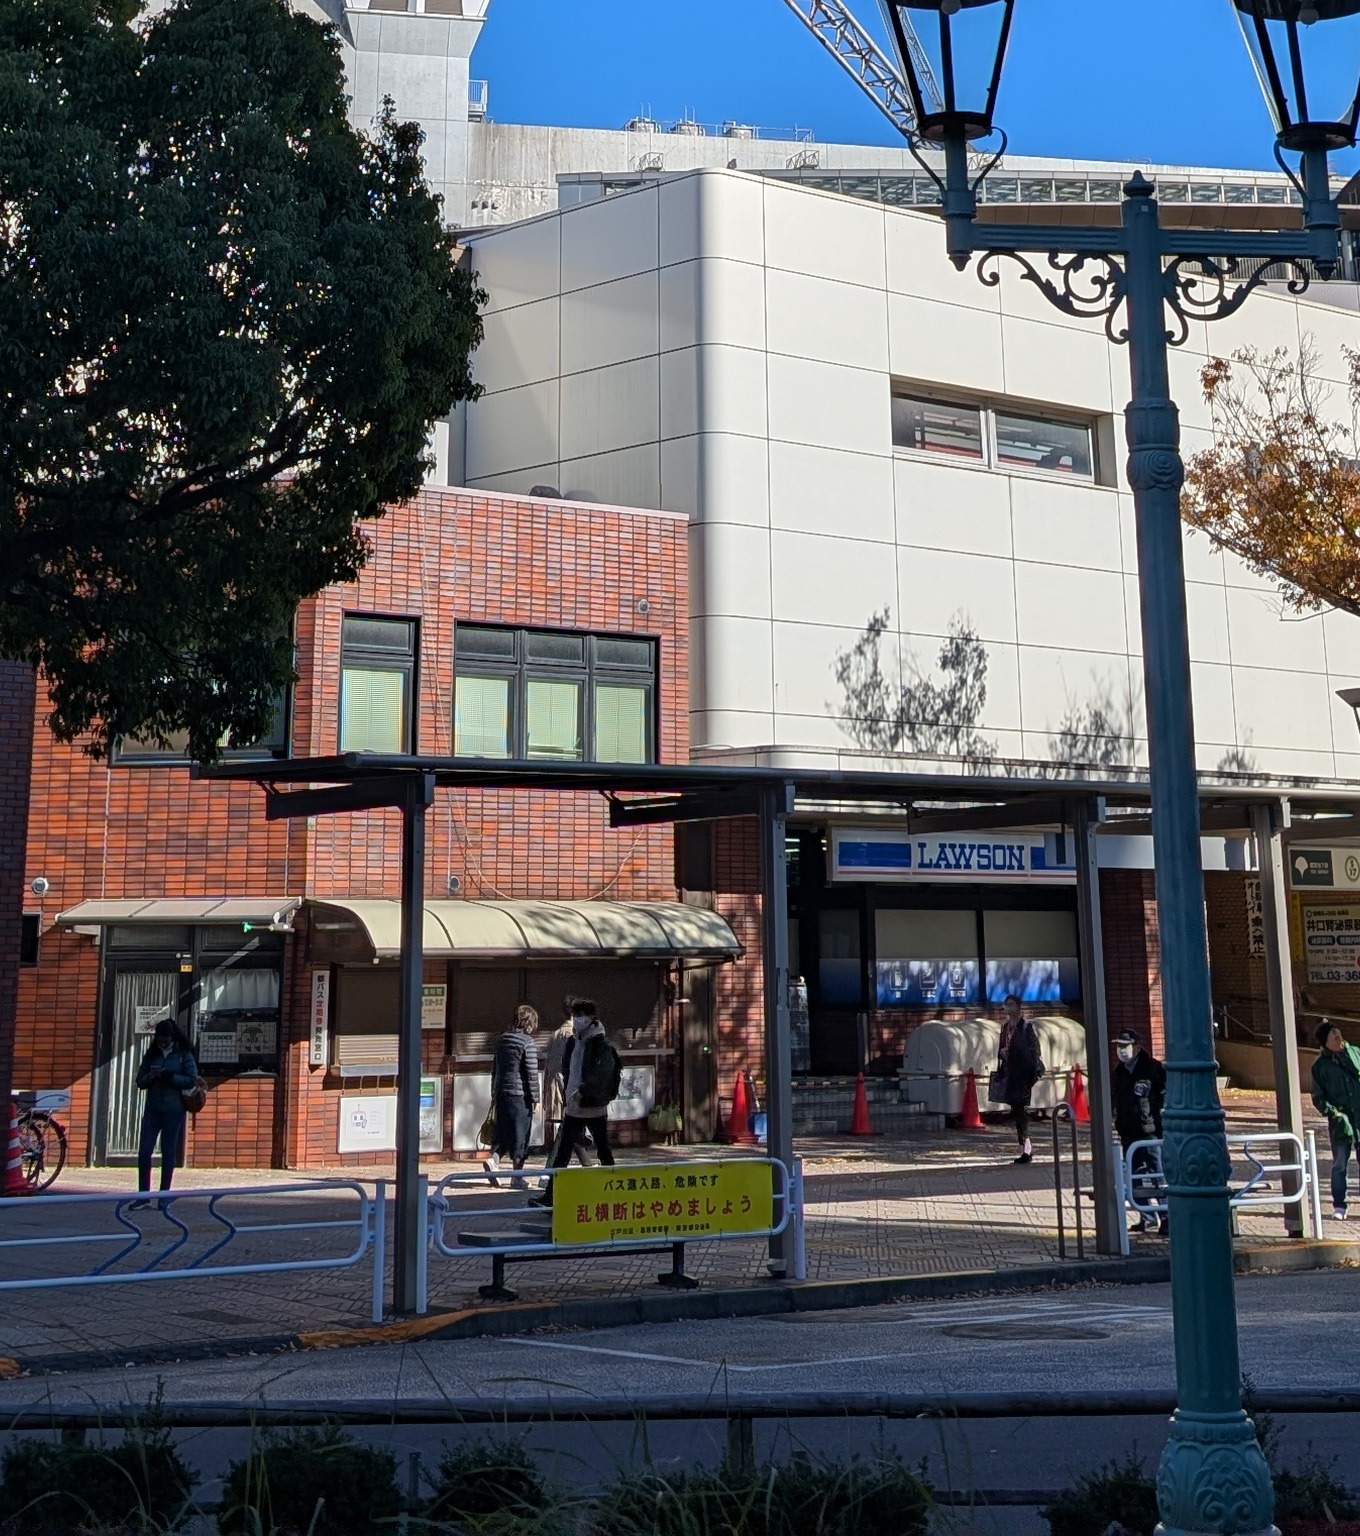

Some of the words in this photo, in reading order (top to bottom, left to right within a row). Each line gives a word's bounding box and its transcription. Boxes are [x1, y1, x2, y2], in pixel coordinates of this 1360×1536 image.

[917, 842, 1025, 871] LAWSON
[576, 1195, 752, 1224] 乱横断はやめましょう
